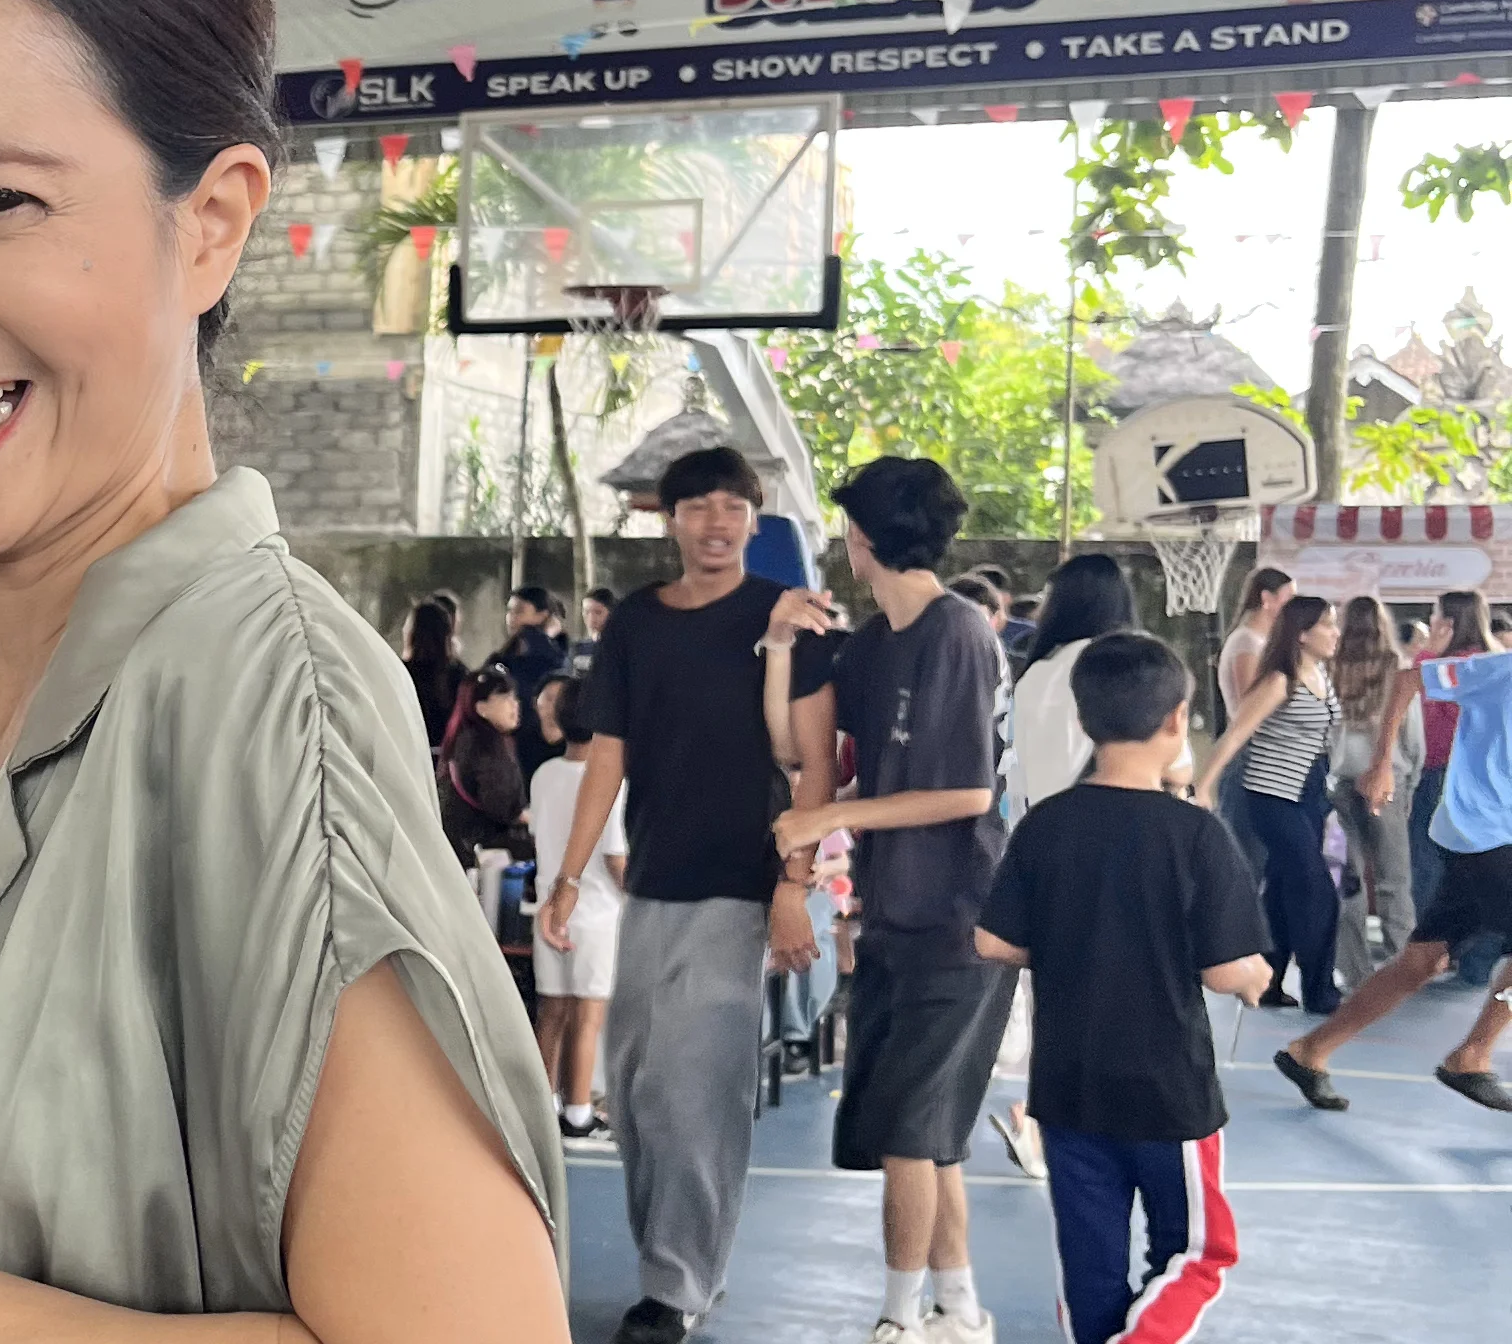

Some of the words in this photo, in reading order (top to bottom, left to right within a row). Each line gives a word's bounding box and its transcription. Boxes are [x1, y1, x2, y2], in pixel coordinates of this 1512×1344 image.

[487, 70, 597, 98] SPEAK
[603, 66, 652, 91] UP
[711, 53, 823, 82] SHOW
[830, 41, 998, 74] RESPECT
[1061, 30, 1165, 59] TAKE
[1172, 28, 1202, 53] A
[1209, 18, 1351, 51] STAND
[359, 73, 436, 106] SLK
